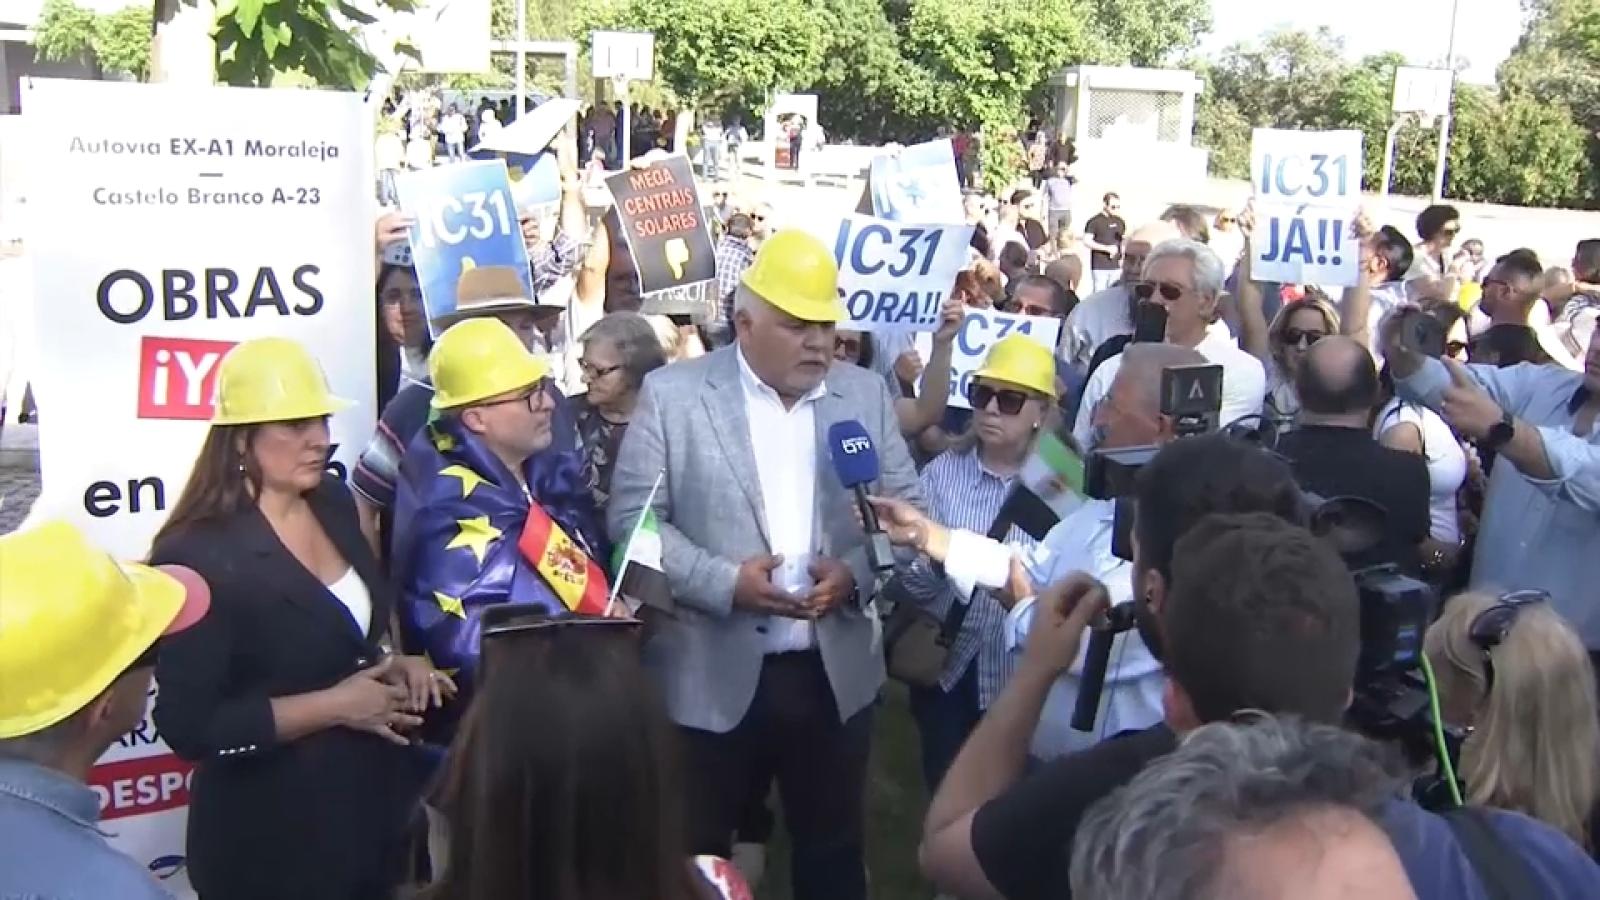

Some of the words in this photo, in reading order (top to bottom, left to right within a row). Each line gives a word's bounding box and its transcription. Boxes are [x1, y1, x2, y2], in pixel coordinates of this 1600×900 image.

[170, 137, 233, 156] EX-A1
[245, 139, 339, 162] Moraleja
[629, 167, 674, 191] MEGA
[1261, 154, 1348, 197] IC31
[93, 187, 178, 205] Castelo
[187, 187, 264, 204] Branco
[272, 187, 320, 205] A-23
[624, 186, 694, 215] CENTRAIS
[419, 188, 511, 249] IC31
[634, 211, 697, 237] SOLARES
[1260, 203, 1344, 266] JÁ!!
[97, 264, 324, 324] OBRAS
[838, 288, 942, 325] ORA!!
[84, 475, 165, 518] en
